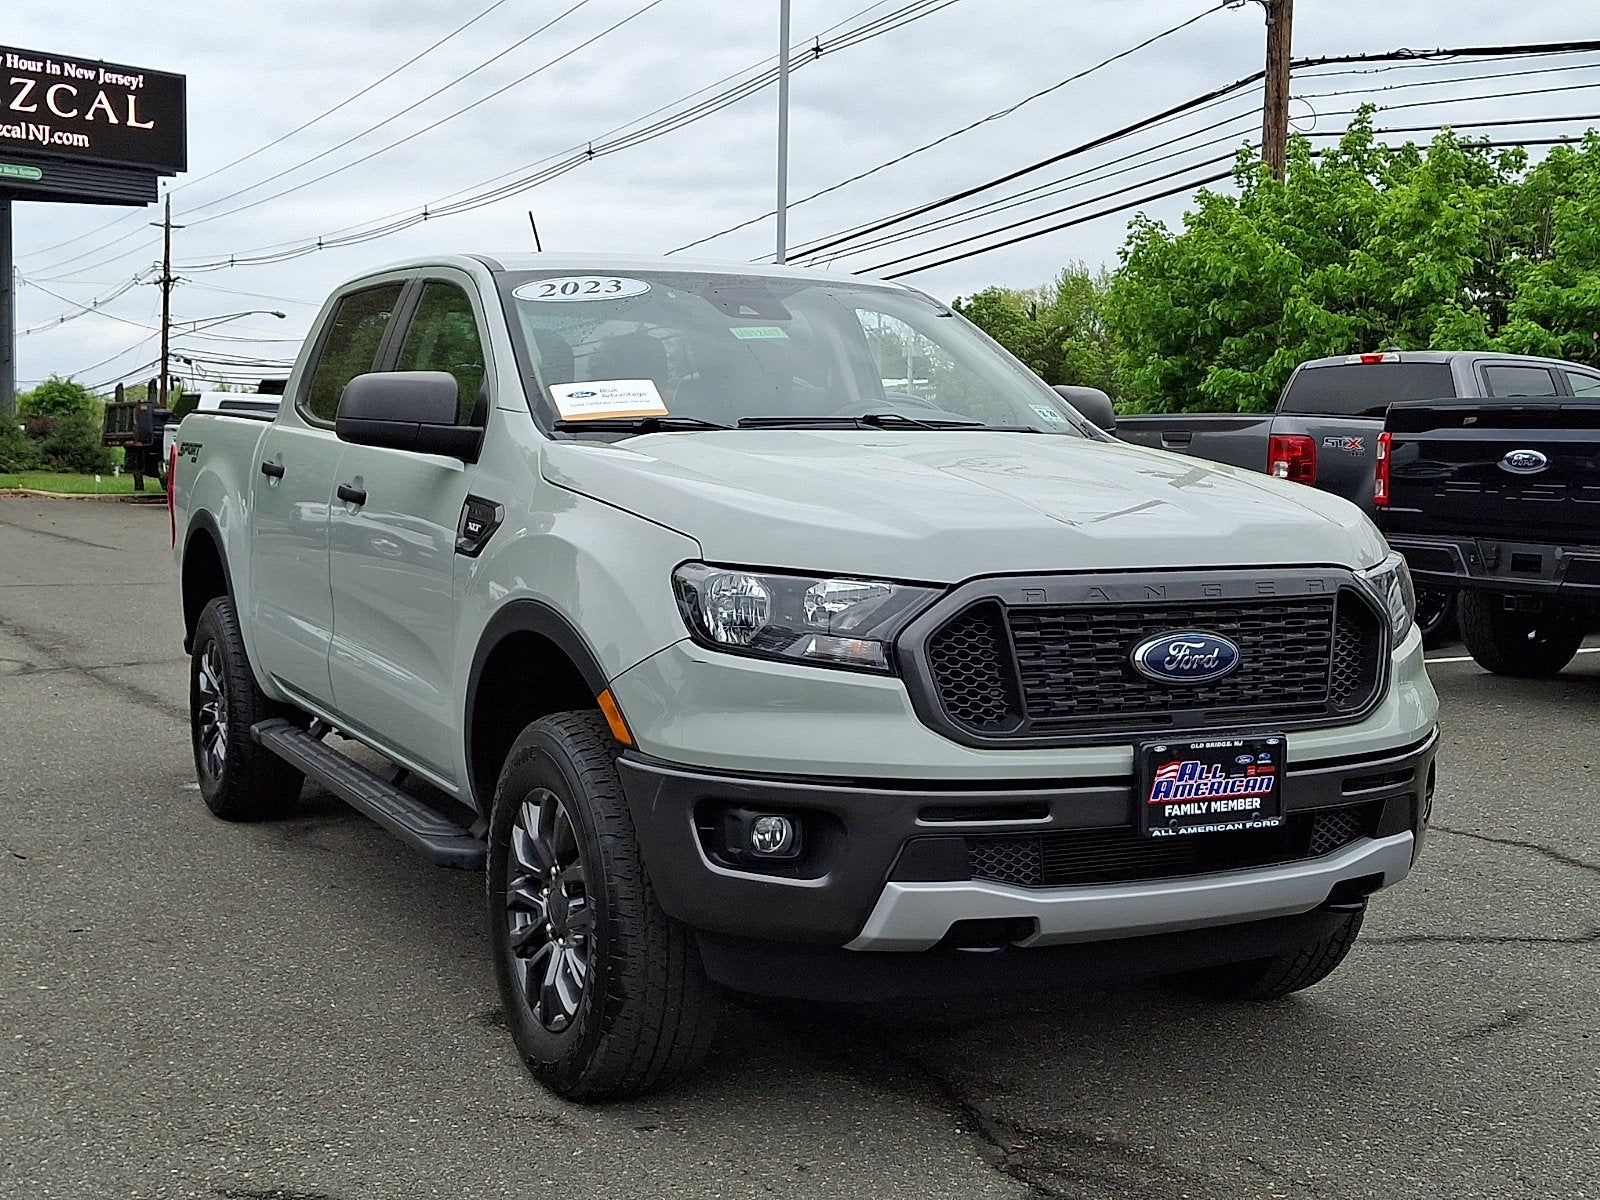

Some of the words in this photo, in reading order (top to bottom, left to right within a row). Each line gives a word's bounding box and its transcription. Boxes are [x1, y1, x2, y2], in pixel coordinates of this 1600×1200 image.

[6, 53, 43, 72] Hour
[46, 60, 61, 75] in
[63, 62, 96, 80] New
[98, 68, 144, 90] Jersey!
[0, 77, 156, 129] ZCAL
[538, 280, 623, 298] 2023
[1322, 435, 1365, 451] STX
[1021, 579, 1327, 603] RANGER
[1164, 641, 1220, 671] Ford
[1177, 761, 1226, 783] ALL
[1164, 802, 1208, 817] FAMILY
[1210, 797, 1261, 812] MEMBER
[1152, 829, 1177, 837] ALL
[1178, 823, 1243, 835] AMERICAN
[1246, 819, 1280, 829] FORD
